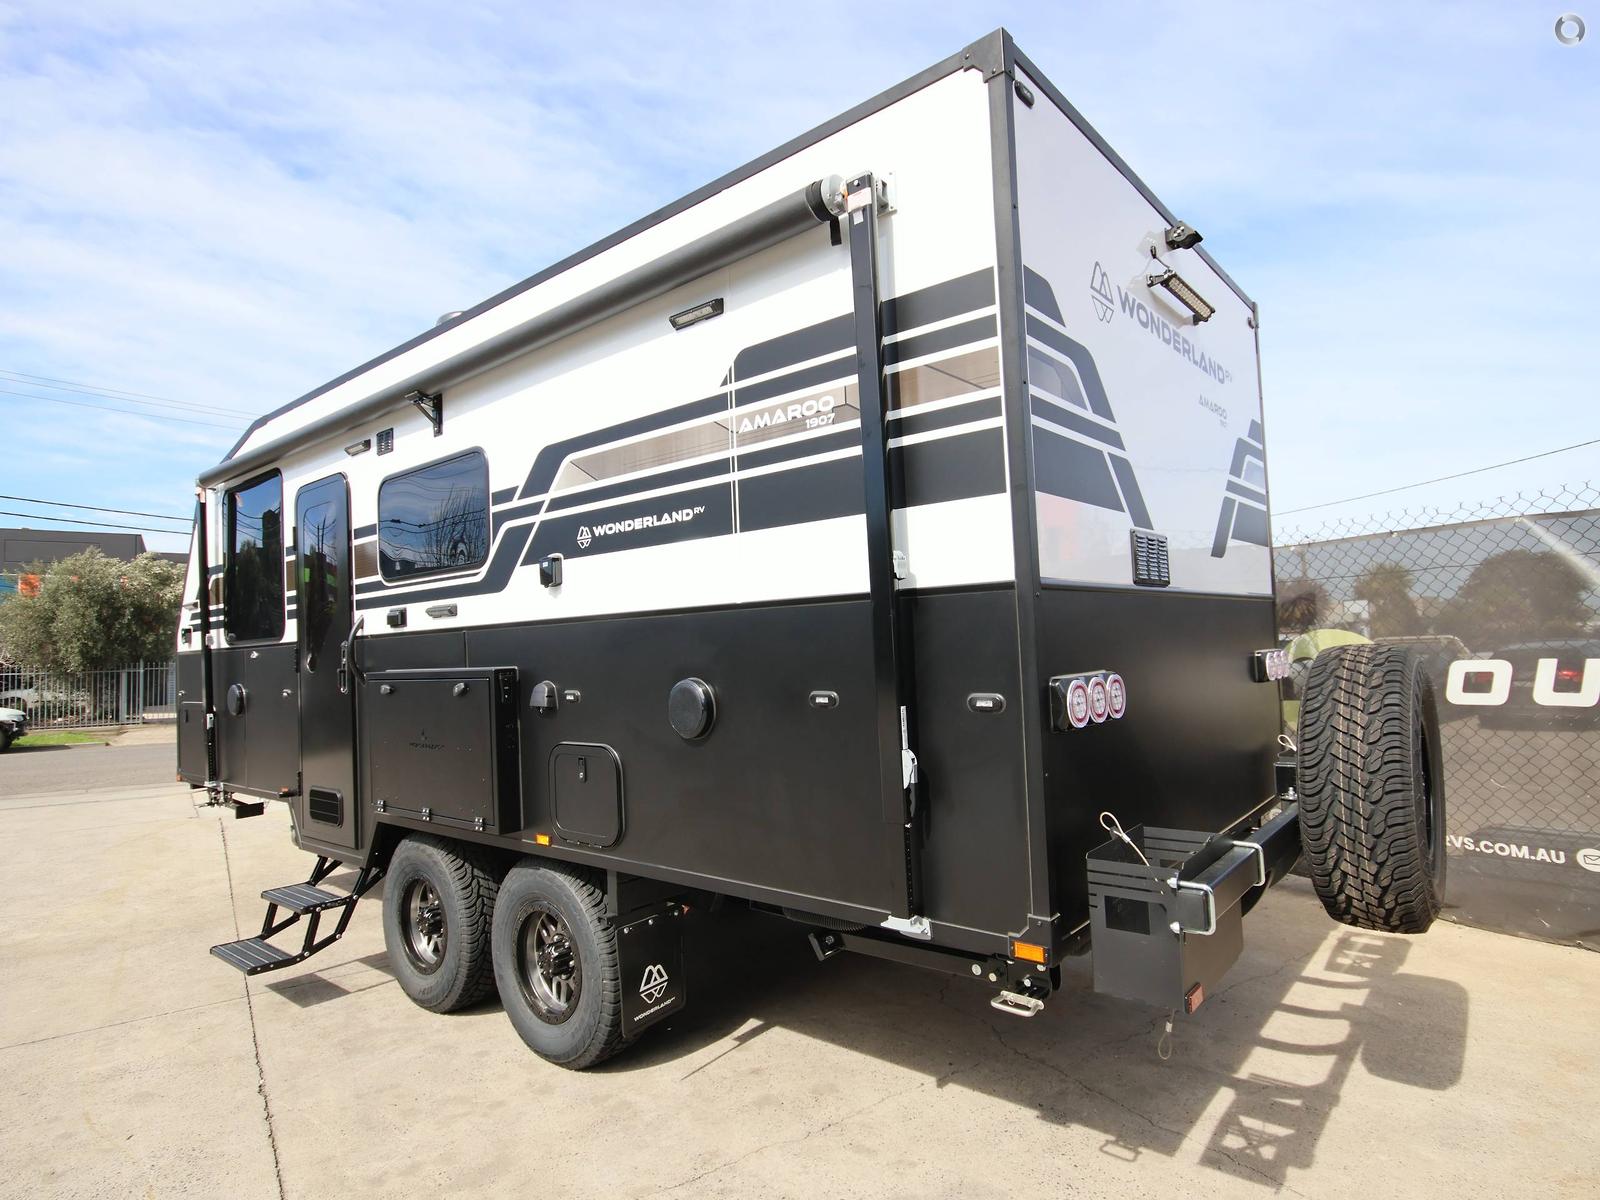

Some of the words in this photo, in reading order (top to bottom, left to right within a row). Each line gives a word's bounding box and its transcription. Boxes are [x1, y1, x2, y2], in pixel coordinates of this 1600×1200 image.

[1117, 284, 1225, 384] WONDERLAND
[739, 395, 835, 434] AMAROO
[805, 412, 835, 429] 1907
[592, 508, 694, 537] WONDERLAND
